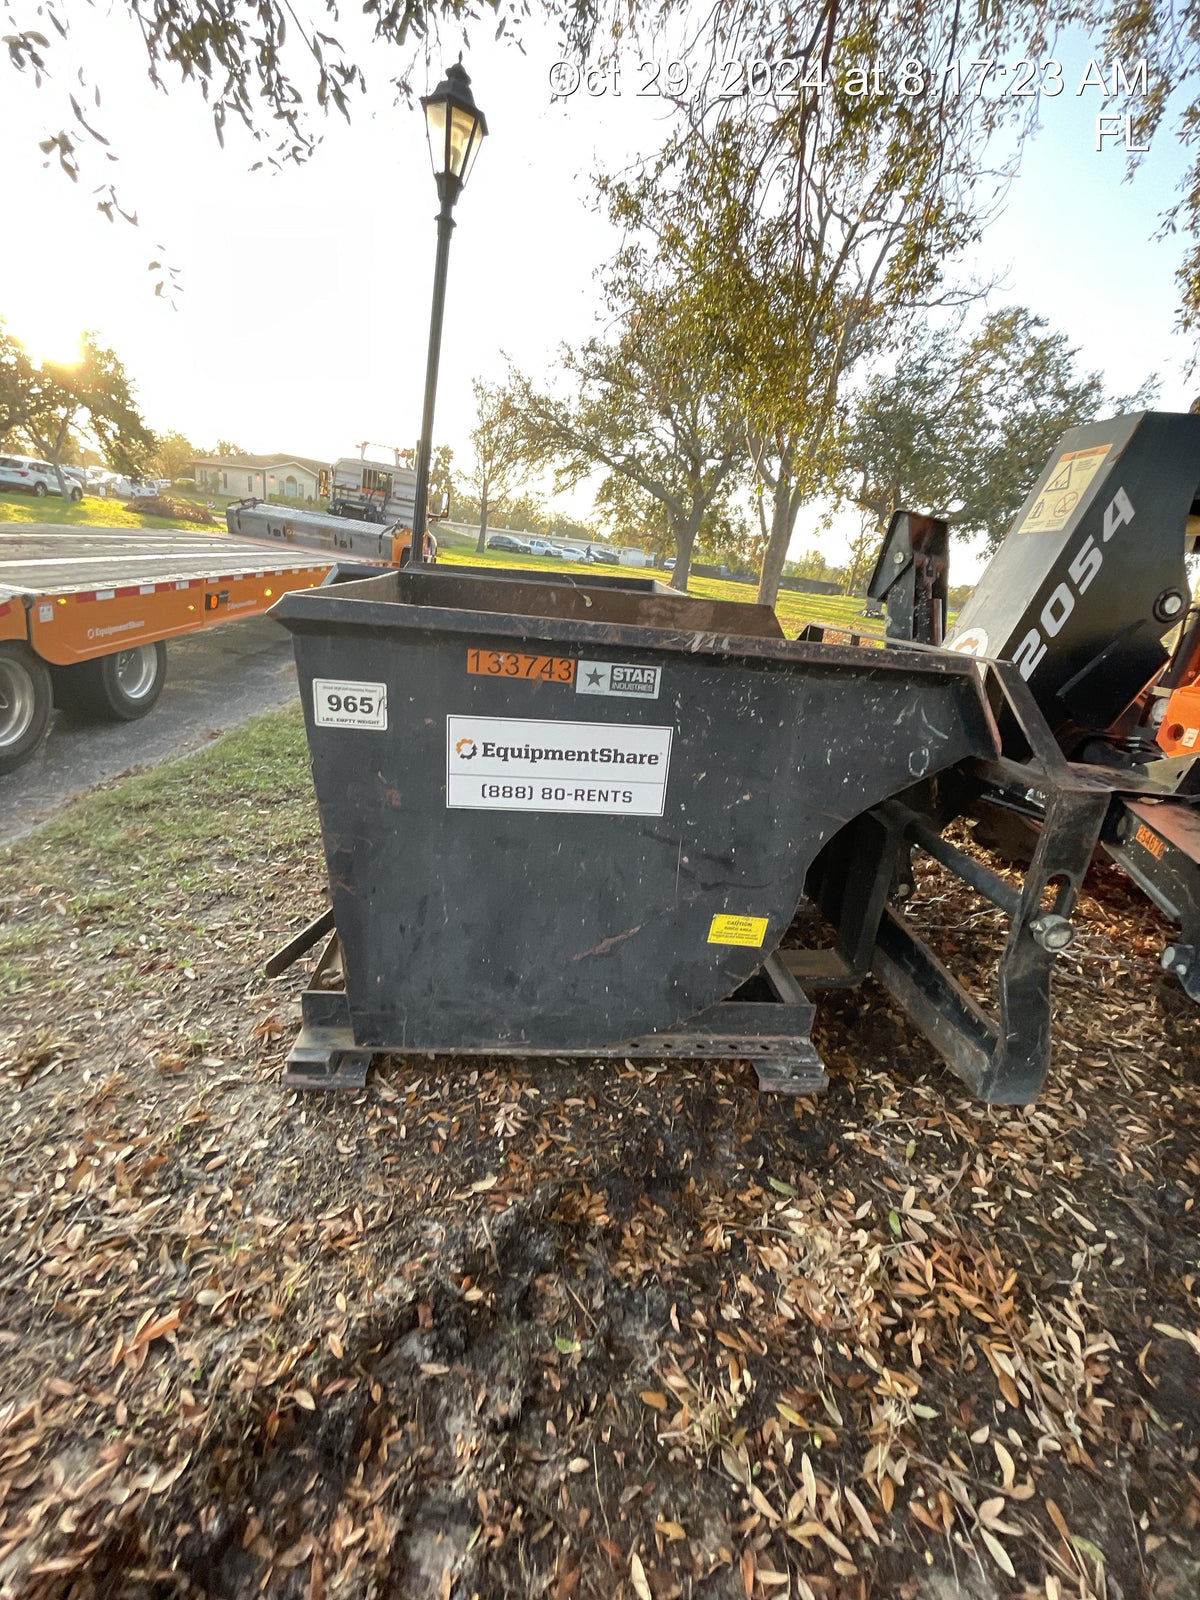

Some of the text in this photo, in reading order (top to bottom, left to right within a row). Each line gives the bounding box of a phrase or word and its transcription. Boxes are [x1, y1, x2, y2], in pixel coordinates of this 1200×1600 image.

[1011, 485, 1136, 683] 2054
[470, 649, 573, 681] 133743
[612, 667, 655, 684] STAR
[611, 682, 654, 692] INDUSTRIES
[327, 694, 374, 715] 965
[481, 741, 660, 766] EquipmentShare
[481, 783, 633, 804] (888) 80-RENTS
